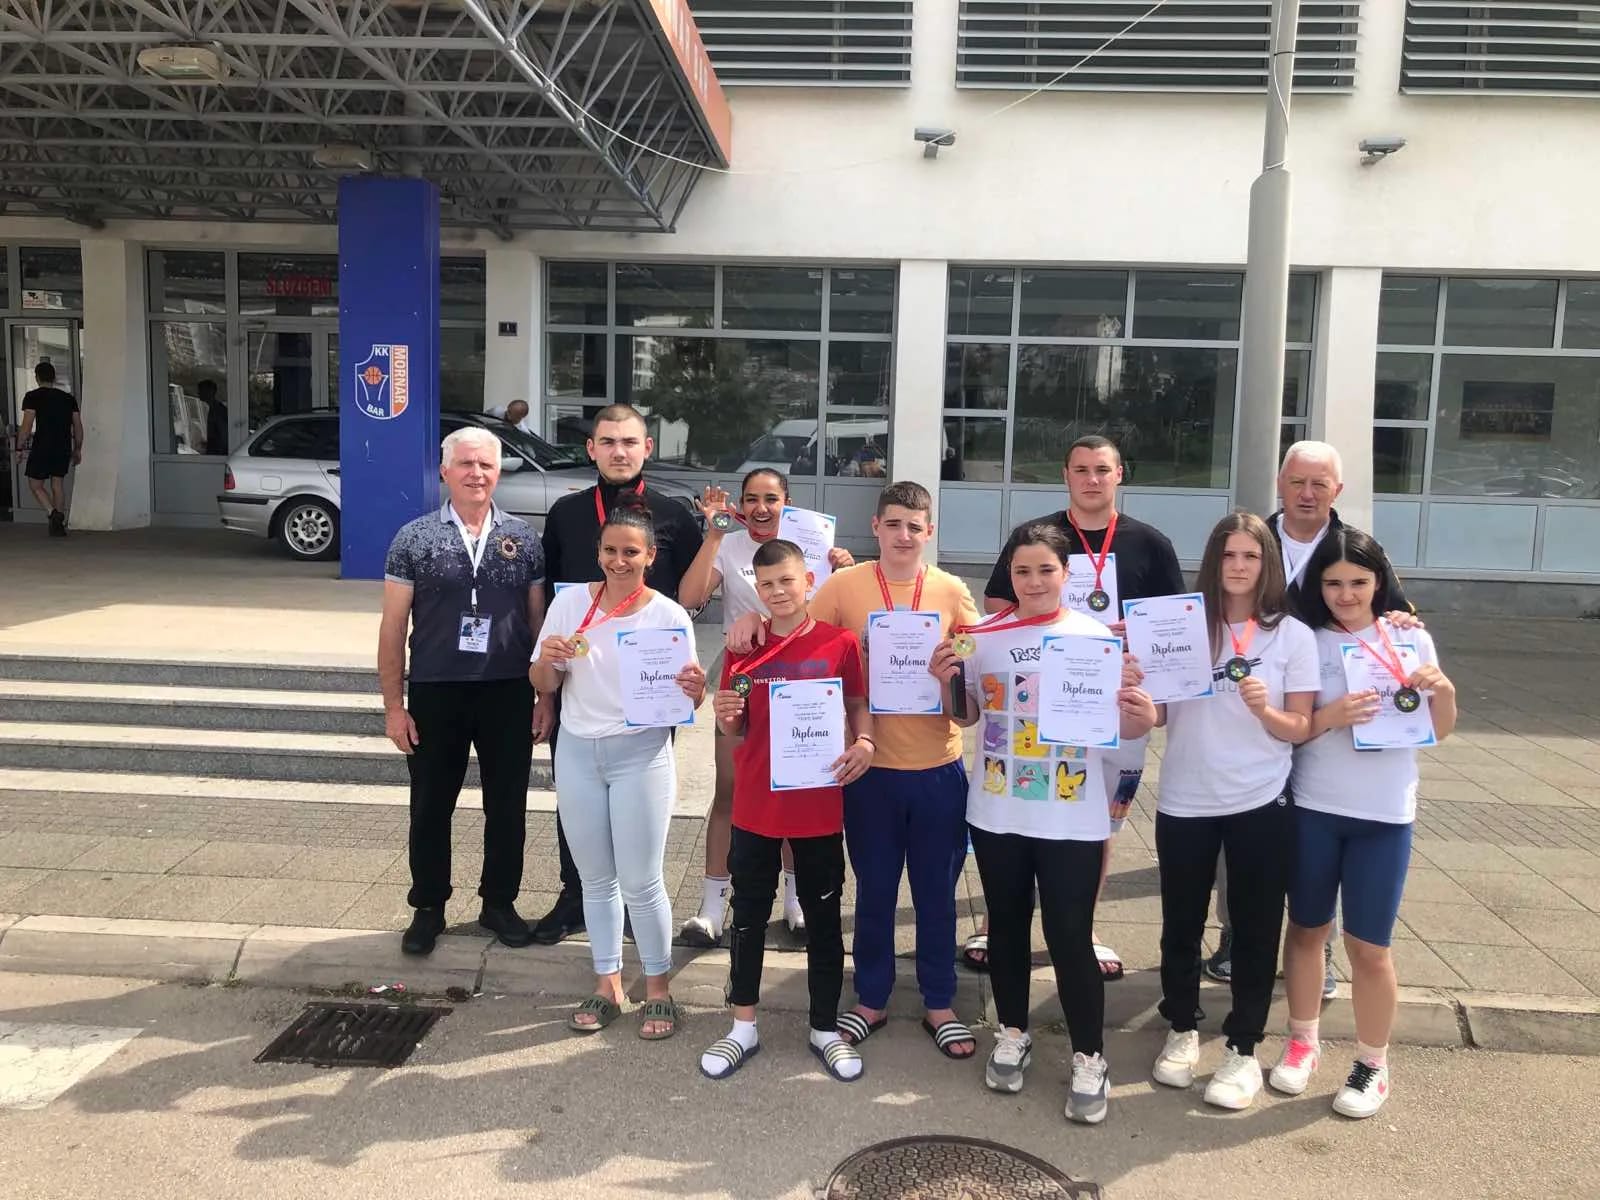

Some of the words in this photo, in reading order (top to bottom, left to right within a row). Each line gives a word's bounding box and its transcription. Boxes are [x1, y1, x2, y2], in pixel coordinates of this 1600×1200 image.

[374, 347, 389, 357] KK
[394, 348, 407, 404] MORNAR
[366, 403, 385, 417] BAR
[1151, 641, 1192, 658] Diploma
[889, 654, 928, 669] Diploma
[1062, 681, 1103, 698] Diploma
[791, 725, 831, 743] Diploma
